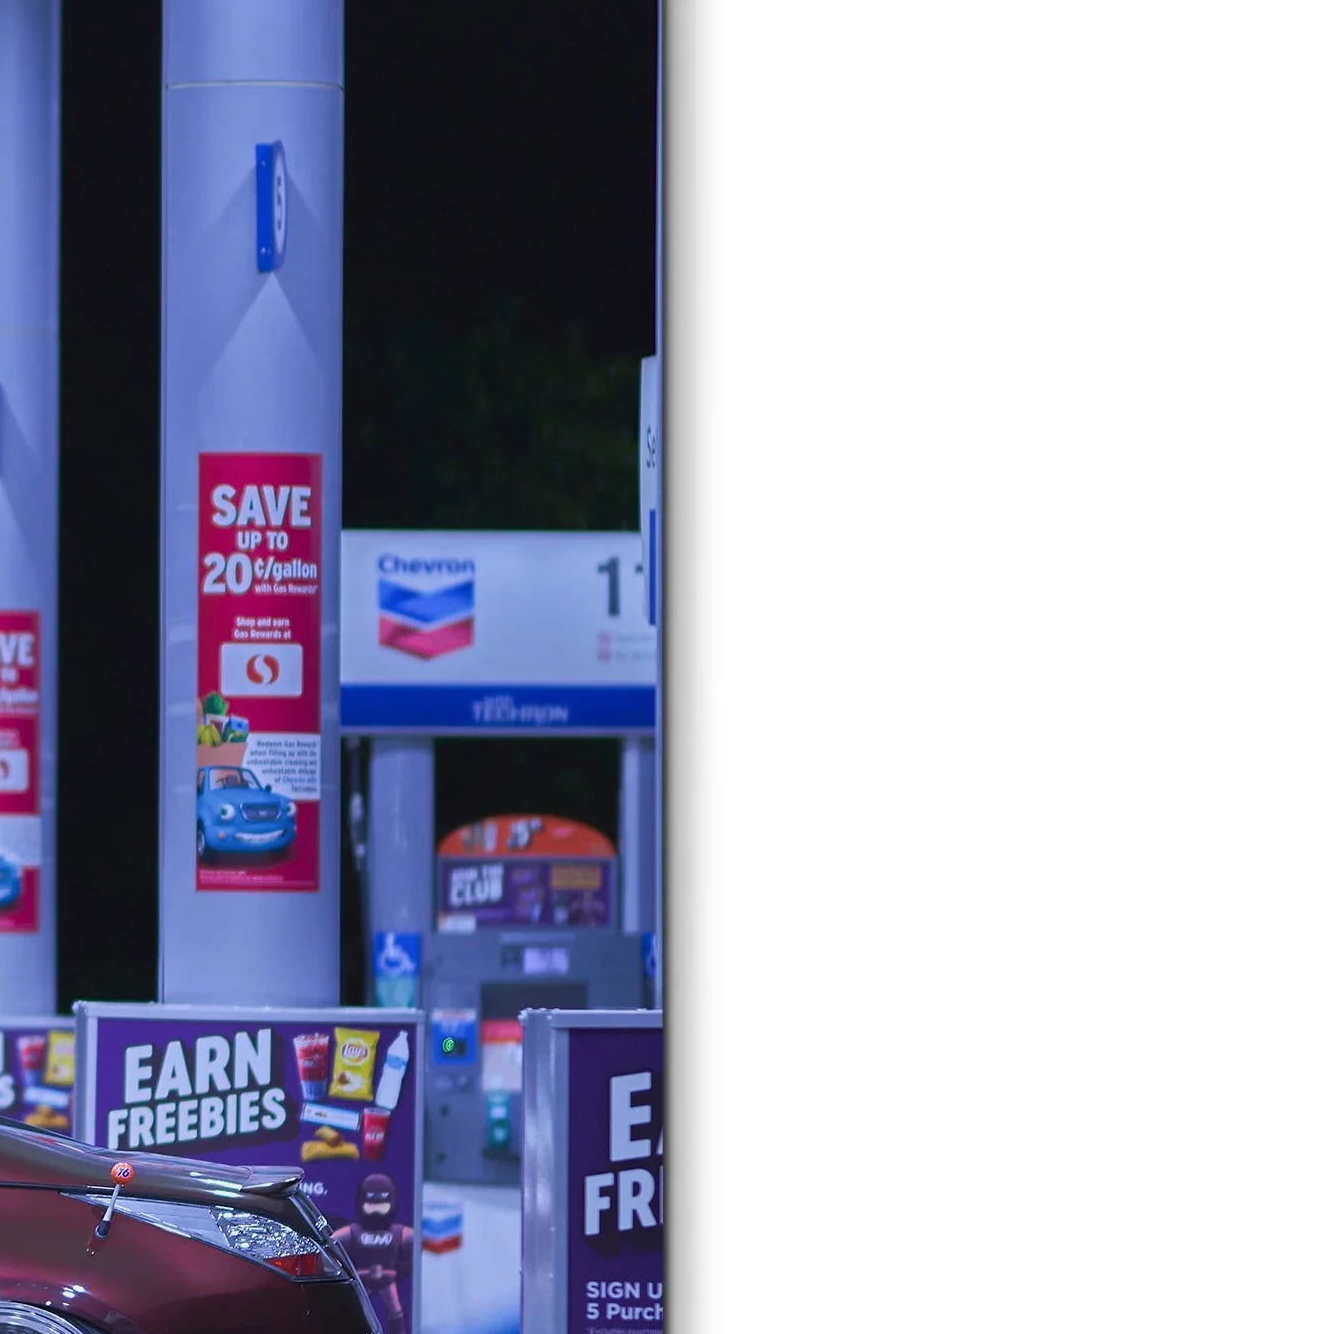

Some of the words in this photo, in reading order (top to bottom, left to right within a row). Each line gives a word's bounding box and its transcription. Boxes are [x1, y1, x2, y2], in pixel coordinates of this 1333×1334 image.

[212, 484, 311, 527] SAVE
[237, 531, 262, 550] UP
[266, 531, 289, 550] TO
[203, 552, 252, 594] 20
[378, 553, 475, 574] Chevron
[255, 584, 271, 593] with
[273, 584, 286, 594] Gas
[236, 617, 255, 627] Shop
[257, 617, 271, 626] and
[273, 618, 289, 626] earn
[234, 629, 248, 638] Gas
[250, 629, 281, 638] Rewards
[283, 630, 291, 638] at
[125, 1028, 271, 1104] EARN
[108, 1087, 286, 1149] FREEBIES
[610, 1071, 663, 1162] E
[117, 1168, 130, 1178] 76
[584, 1165, 663, 1236] FR
[586, 1282, 640, 1299] SIGN
[587, 1303, 599, 1320] 5
